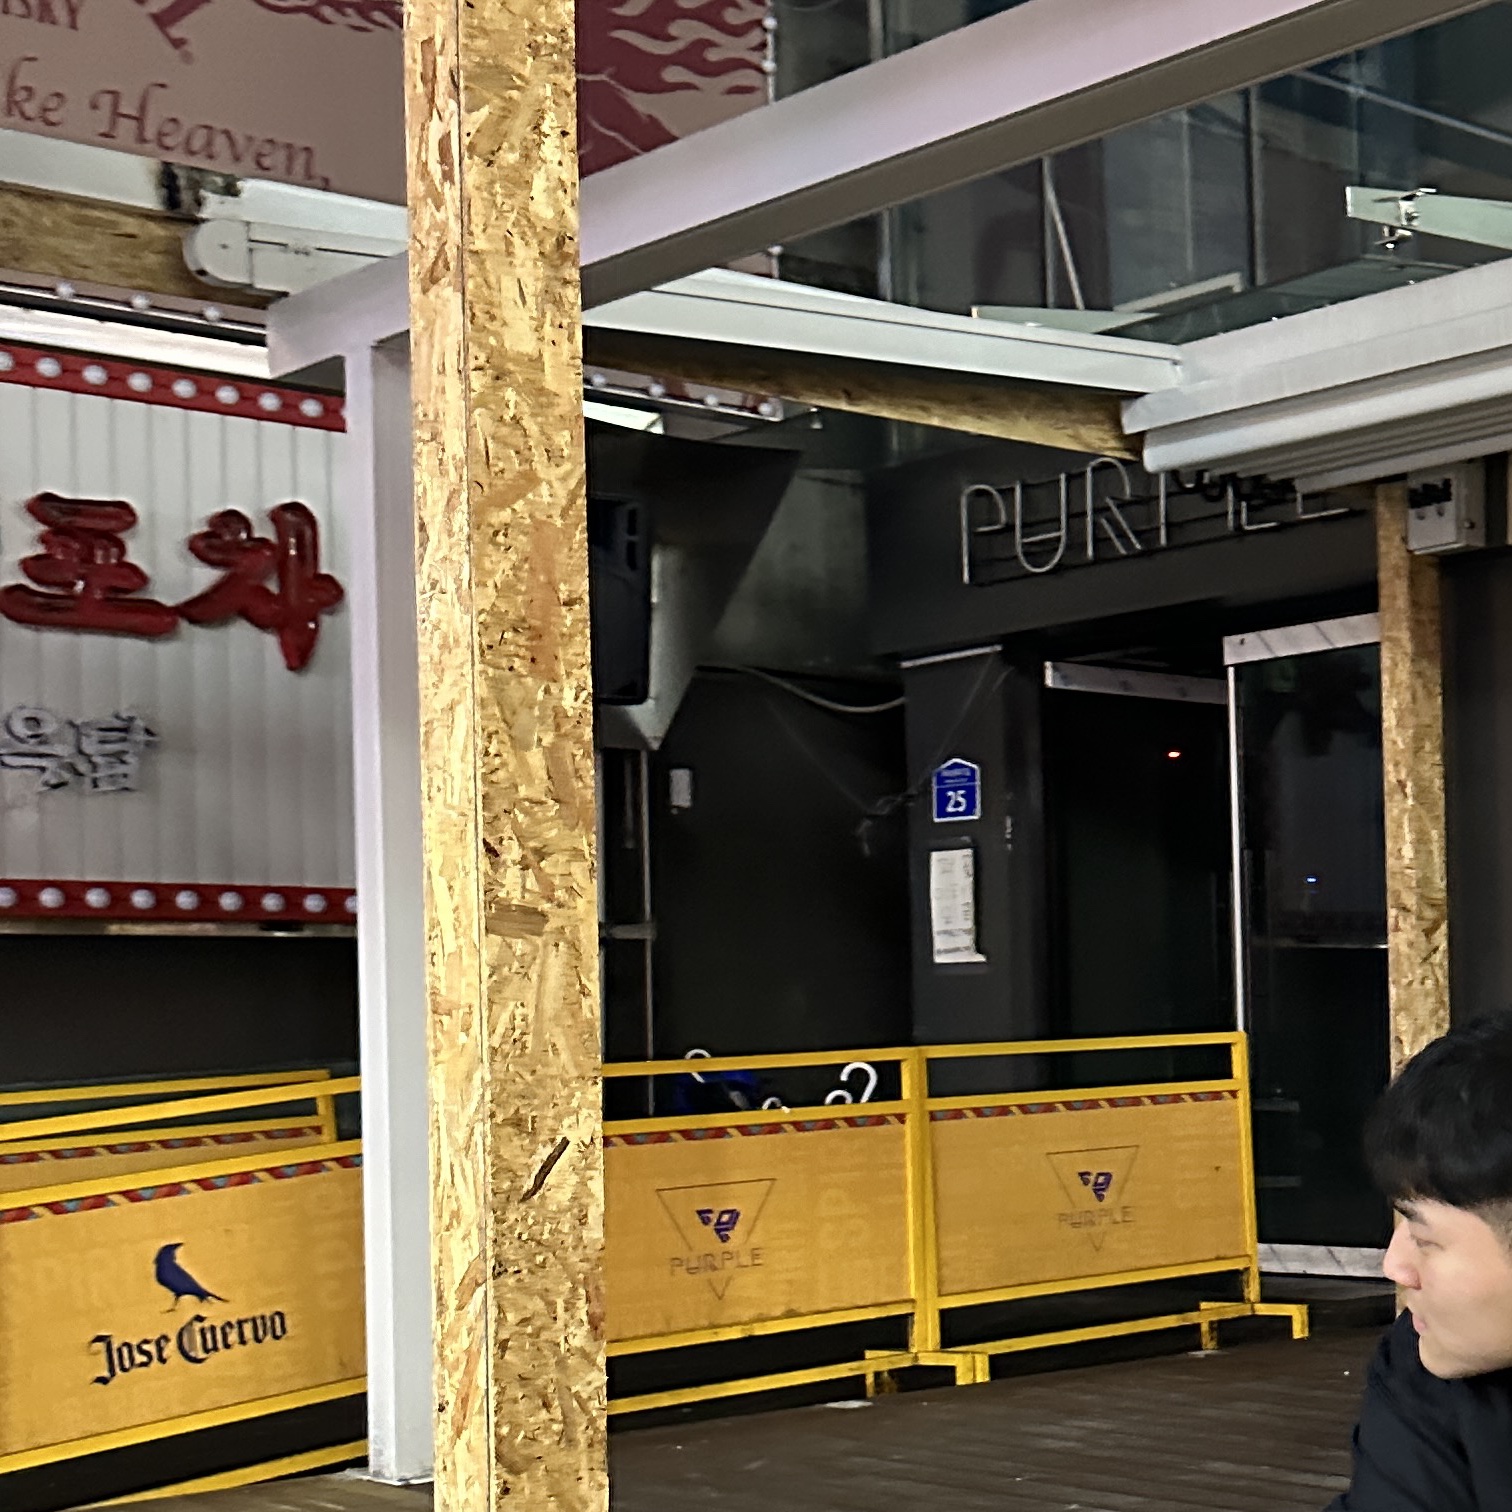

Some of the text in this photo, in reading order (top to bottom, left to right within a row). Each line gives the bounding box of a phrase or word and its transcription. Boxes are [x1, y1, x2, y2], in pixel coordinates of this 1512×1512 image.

[89, 82, 331, 191] Heaven,
[0, 491, 344, 672] 포차
[945, 790, 967, 813] 25
[670, 1247, 763, 1278] PURPLE
[89, 1311, 287, 1386] Jose Cuervo
